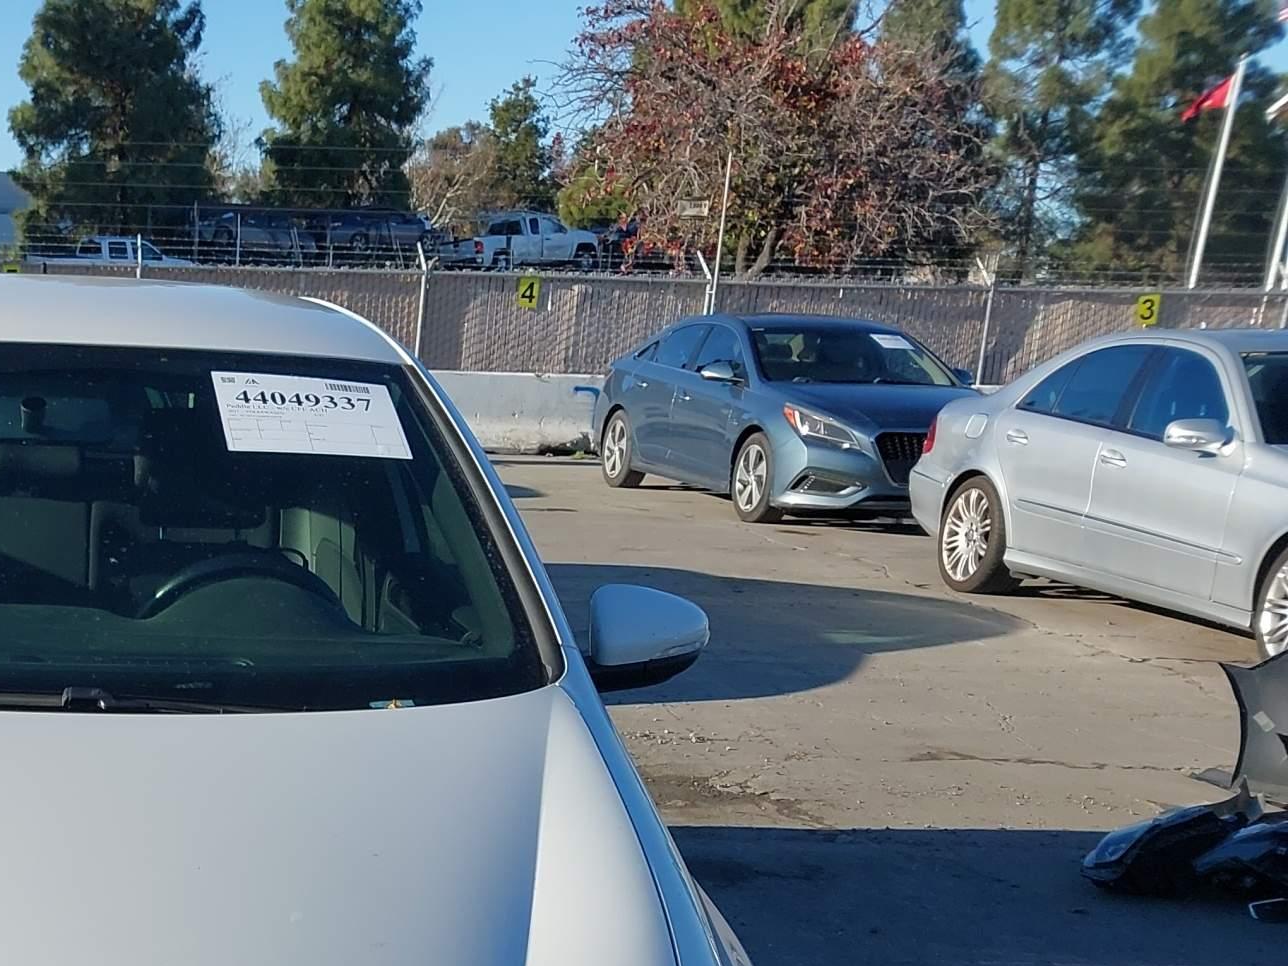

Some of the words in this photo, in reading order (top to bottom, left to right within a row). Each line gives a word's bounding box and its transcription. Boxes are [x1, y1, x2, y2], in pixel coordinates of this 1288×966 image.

[520, 281, 535, 303] 4
[1139, 299, 1154, 320] 3
[235, 389, 371, 412] 44049337
